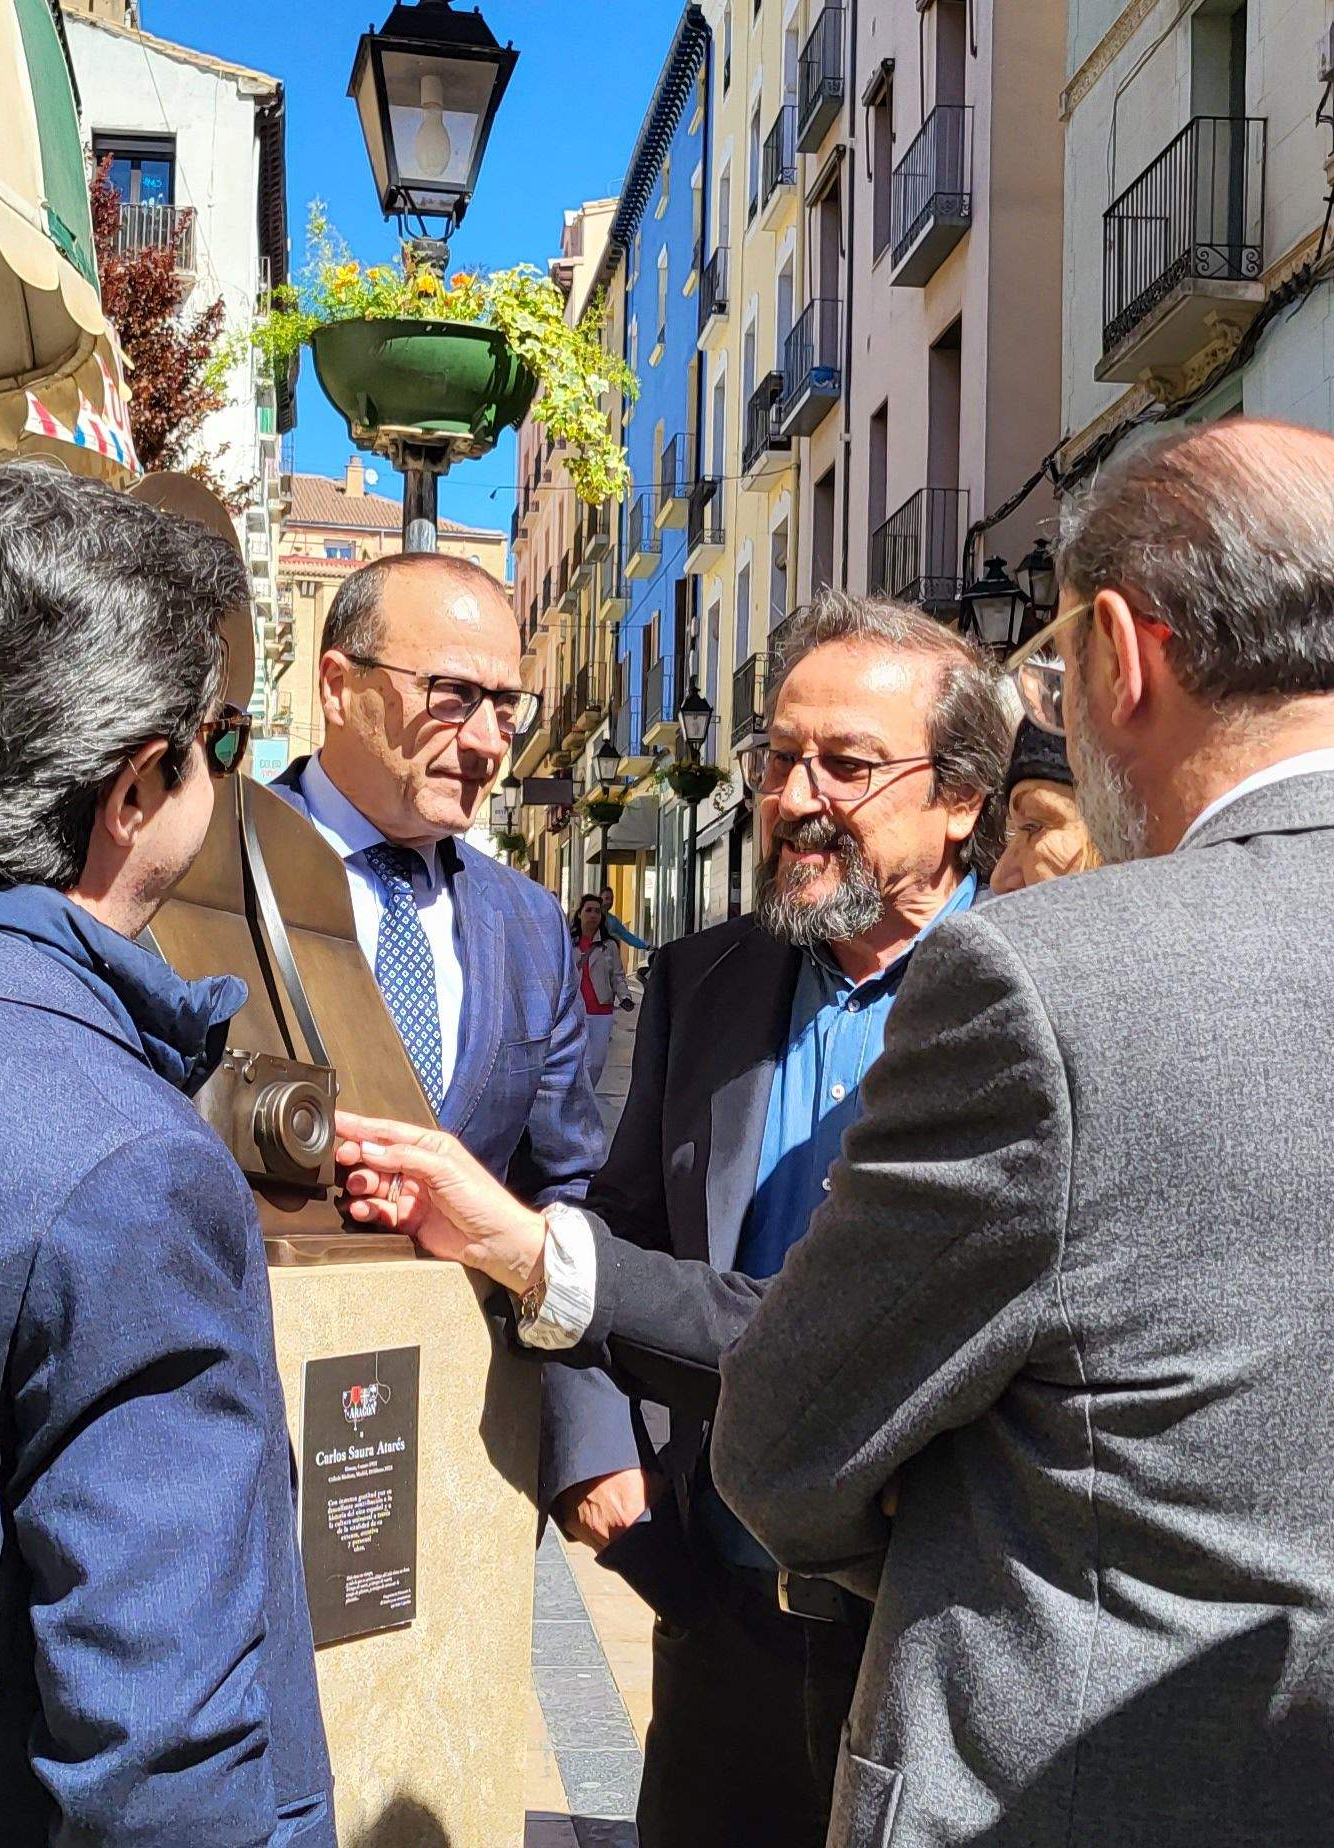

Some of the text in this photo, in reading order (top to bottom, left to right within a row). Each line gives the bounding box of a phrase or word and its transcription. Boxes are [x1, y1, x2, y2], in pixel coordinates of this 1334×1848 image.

[316, 1449, 347, 1466] Carlos
[348, 1445, 374, 1460] Saura
[377, 1436, 405, 1454] Atarés
